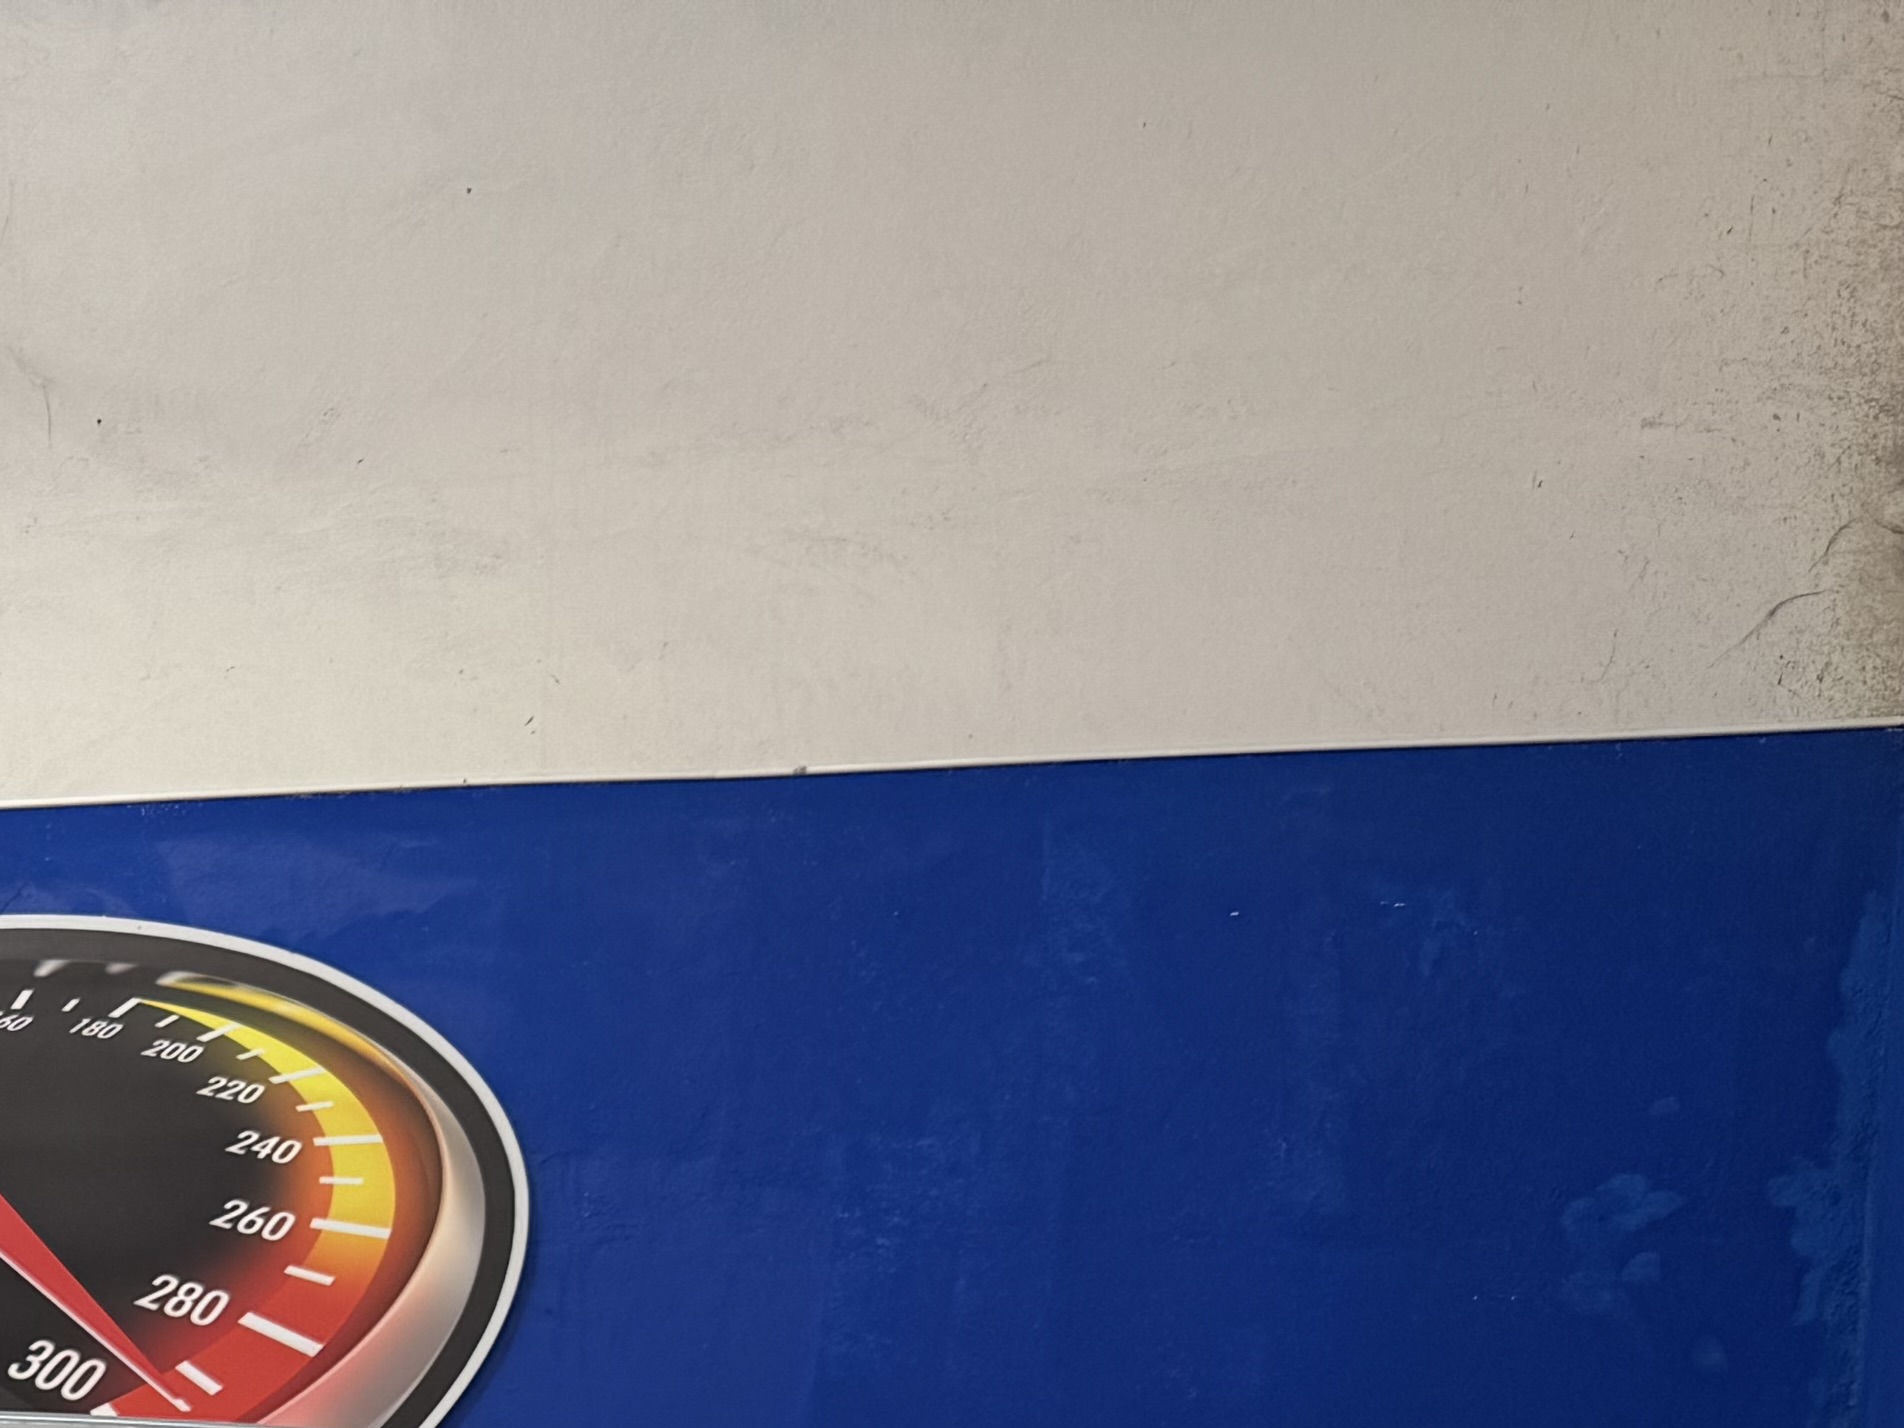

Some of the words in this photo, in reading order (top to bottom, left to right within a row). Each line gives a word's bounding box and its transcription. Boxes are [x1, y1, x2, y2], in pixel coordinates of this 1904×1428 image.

[69, 1018, 124, 1040] 180
[141, 1039, 204, 1063] 200
[196, 1075, 265, 1104] 220
[224, 1129, 302, 1164] 240
[209, 1198, 296, 1242] 260
[133, 1274, 230, 1327] 280
[7, 1339, 107, 1401] 300
